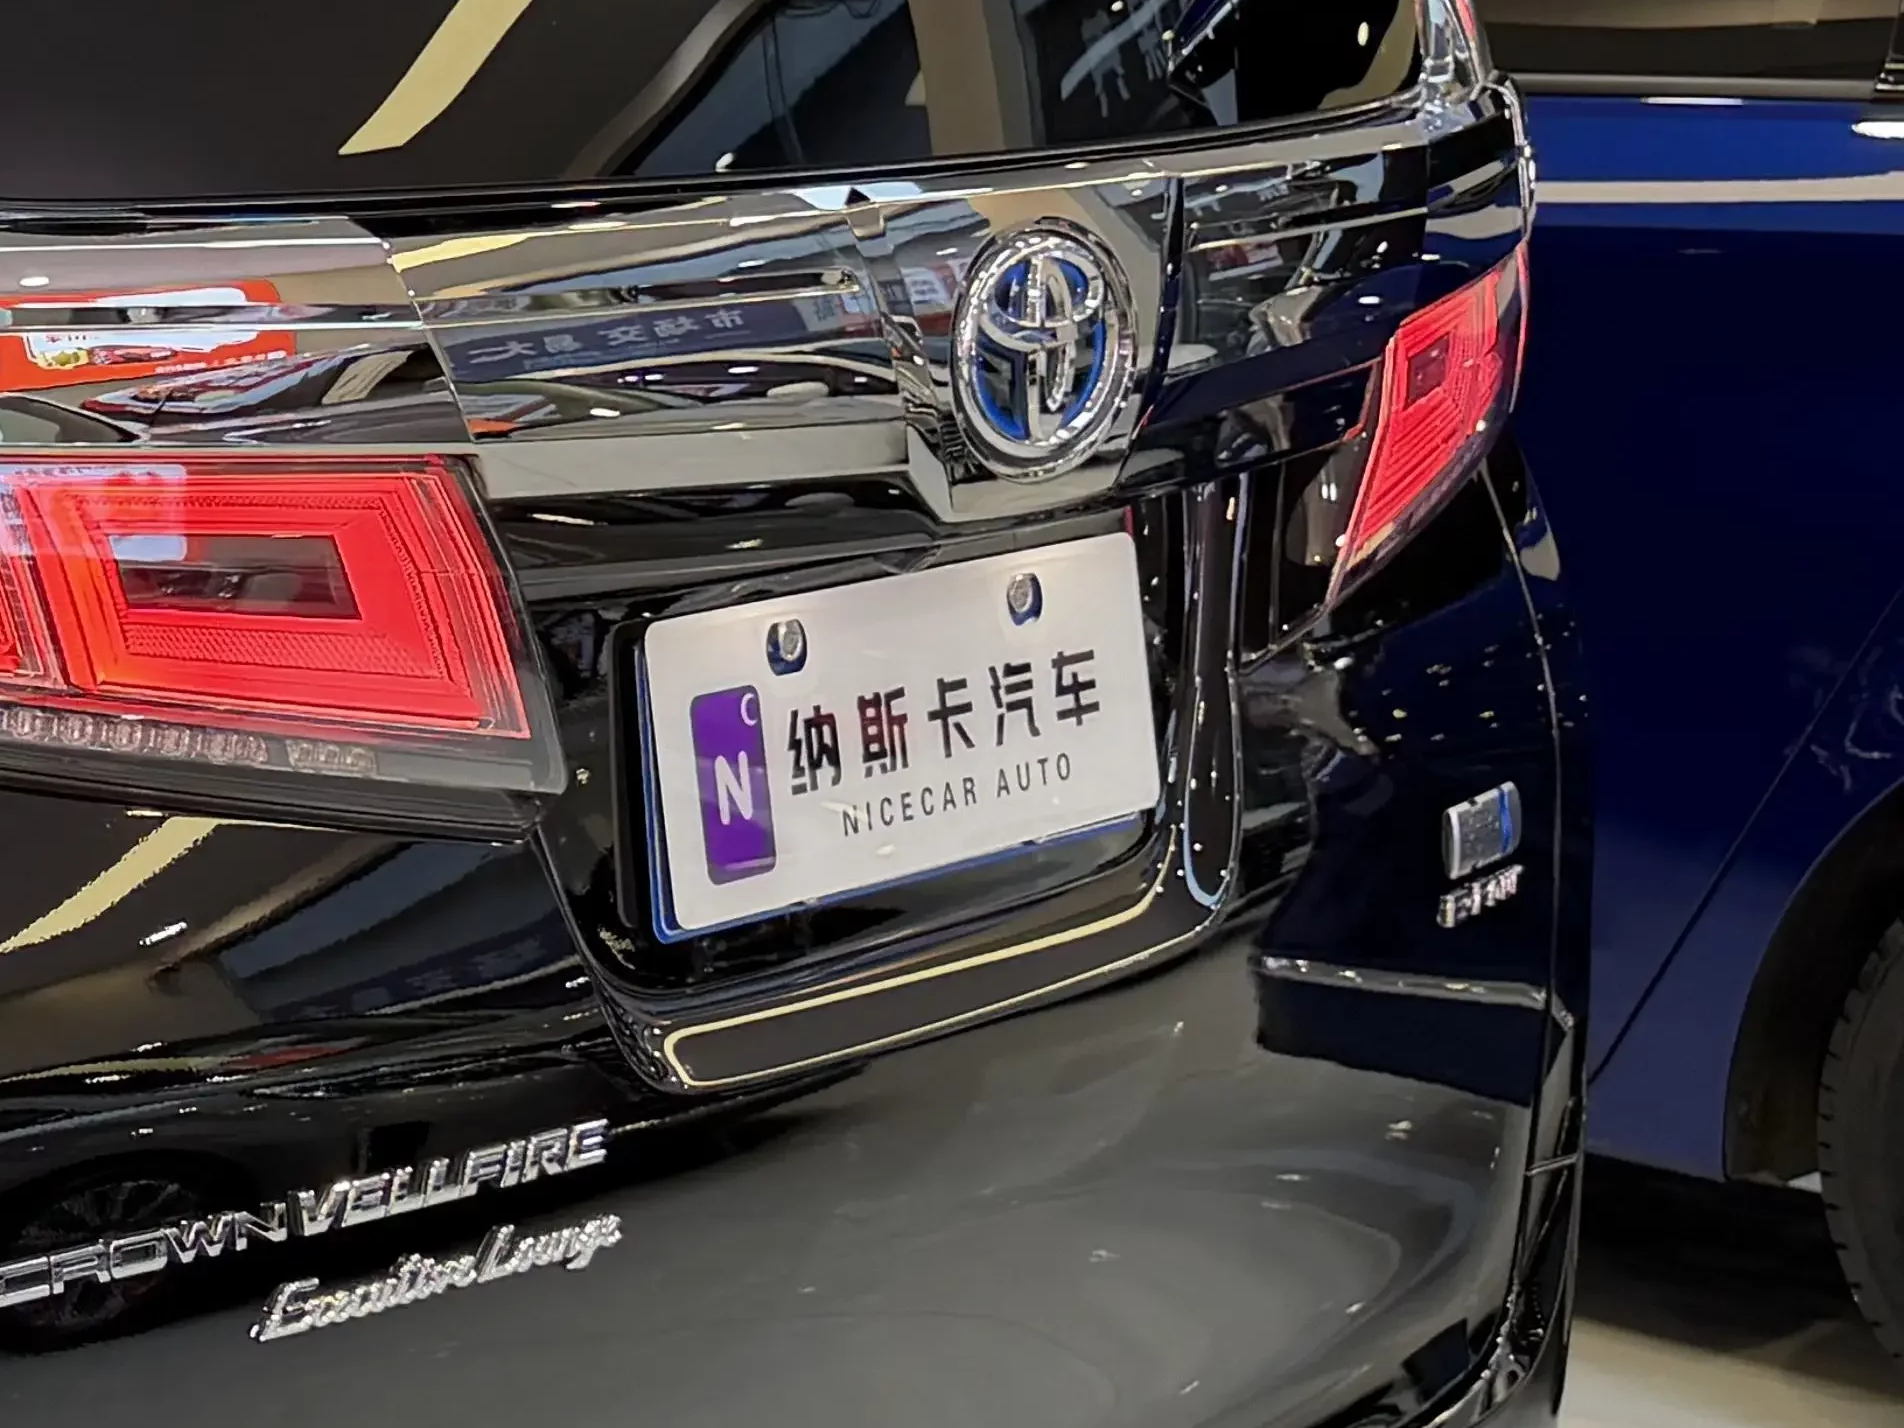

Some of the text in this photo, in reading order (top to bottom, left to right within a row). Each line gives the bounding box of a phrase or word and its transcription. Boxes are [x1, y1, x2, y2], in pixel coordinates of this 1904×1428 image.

[787, 649, 1101, 796] 纳斯卡汽车
[714, 750, 754, 826] N
[842, 753, 1072, 836] NICECAR AUTO
[292, 1118, 609, 1236] VELLFIRE
[249, 1213, 623, 1342] Executive Lounge
